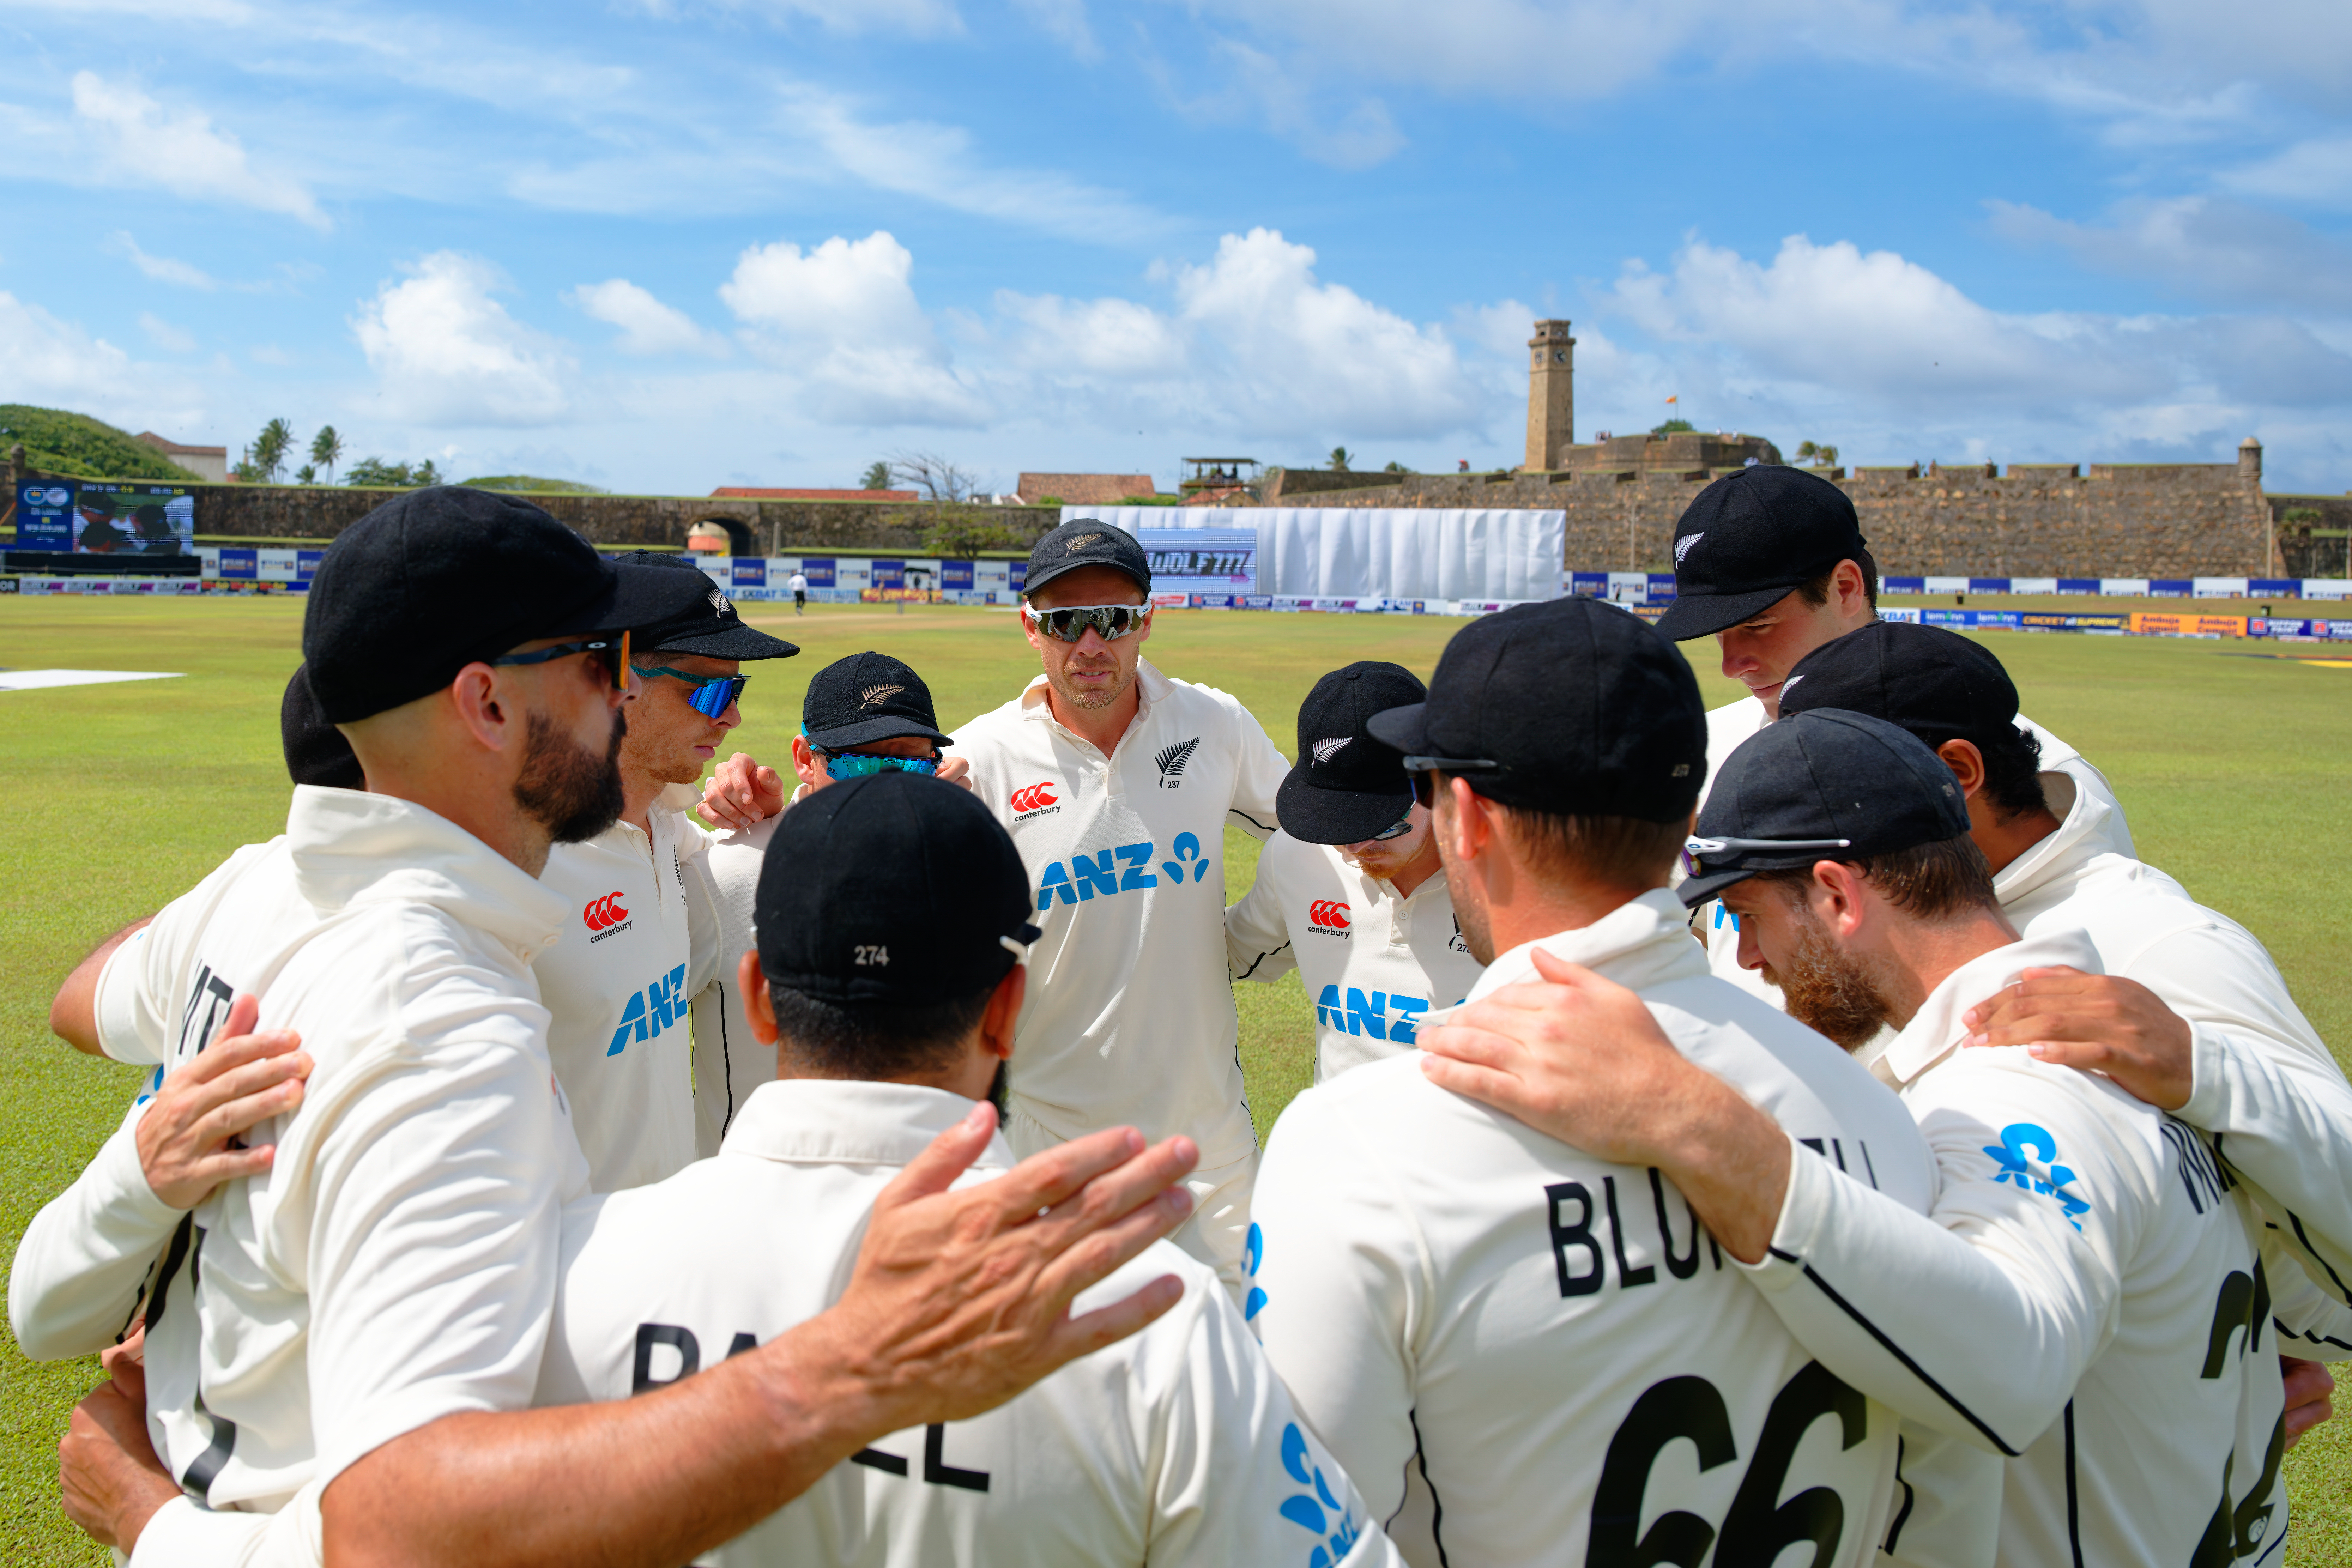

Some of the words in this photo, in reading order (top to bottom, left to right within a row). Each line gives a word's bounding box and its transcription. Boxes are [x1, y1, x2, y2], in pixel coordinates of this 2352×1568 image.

[1167, 781, 1180, 789] 237
[1015, 805, 1061, 822] canterbury
[1037, 842, 1158, 911] ANZ
[590, 920, 633, 943] canterbury
[1308, 926, 1350, 939] canterbury
[854, 945, 890, 966] 274
[606, 963, 688, 1057] ANZ
[1317, 984, 1429, 1045] ANZ
[1584, 1359, 1867, 1568] 66
